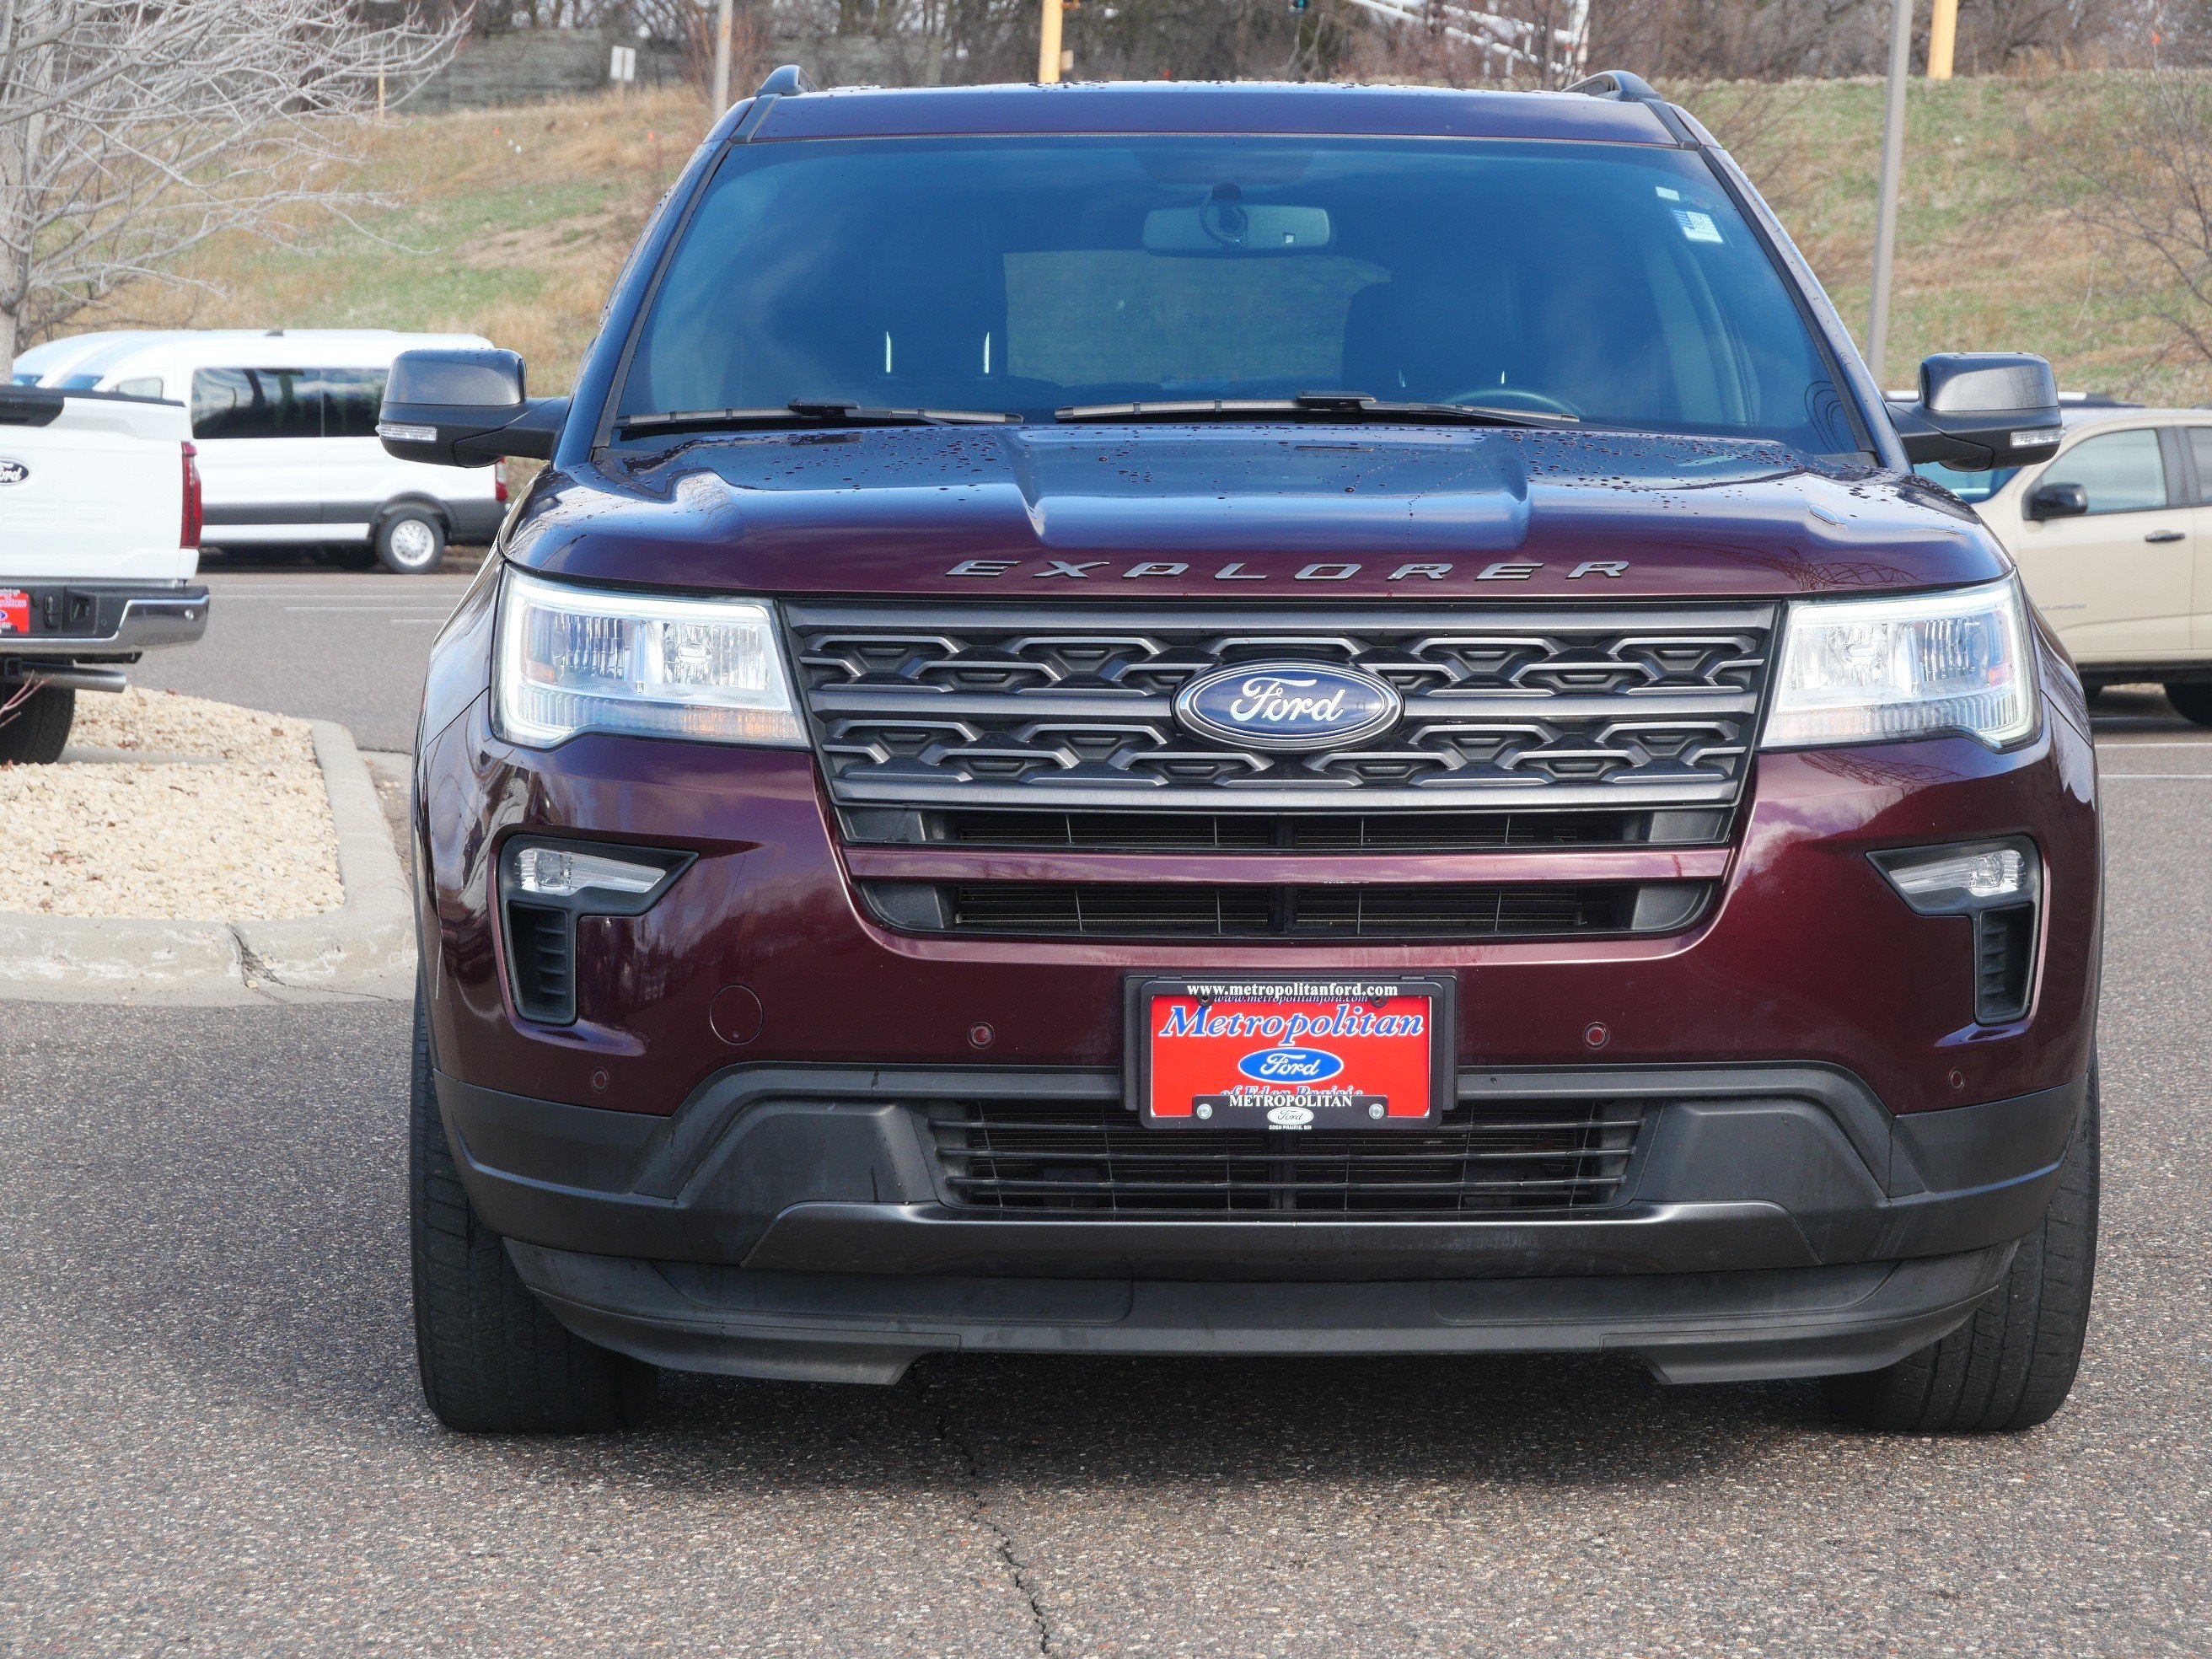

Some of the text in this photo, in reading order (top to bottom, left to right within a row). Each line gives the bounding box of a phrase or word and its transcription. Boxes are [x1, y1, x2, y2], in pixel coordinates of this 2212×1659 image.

[0, 463, 23, 481] ord
[945, 559, 1631, 581] EXPLORER
[1229, 676, 1346, 722] Ford
[1187, 983, 1399, 999] www.metropolitanford.com
[1158, 1004, 1425, 1046] Metropolitan
[1260, 1053, 1320, 1076] Ford
[1229, 1095, 1352, 1107] METROPOLITAN
[1277, 1110, 1304, 1121] Ford
